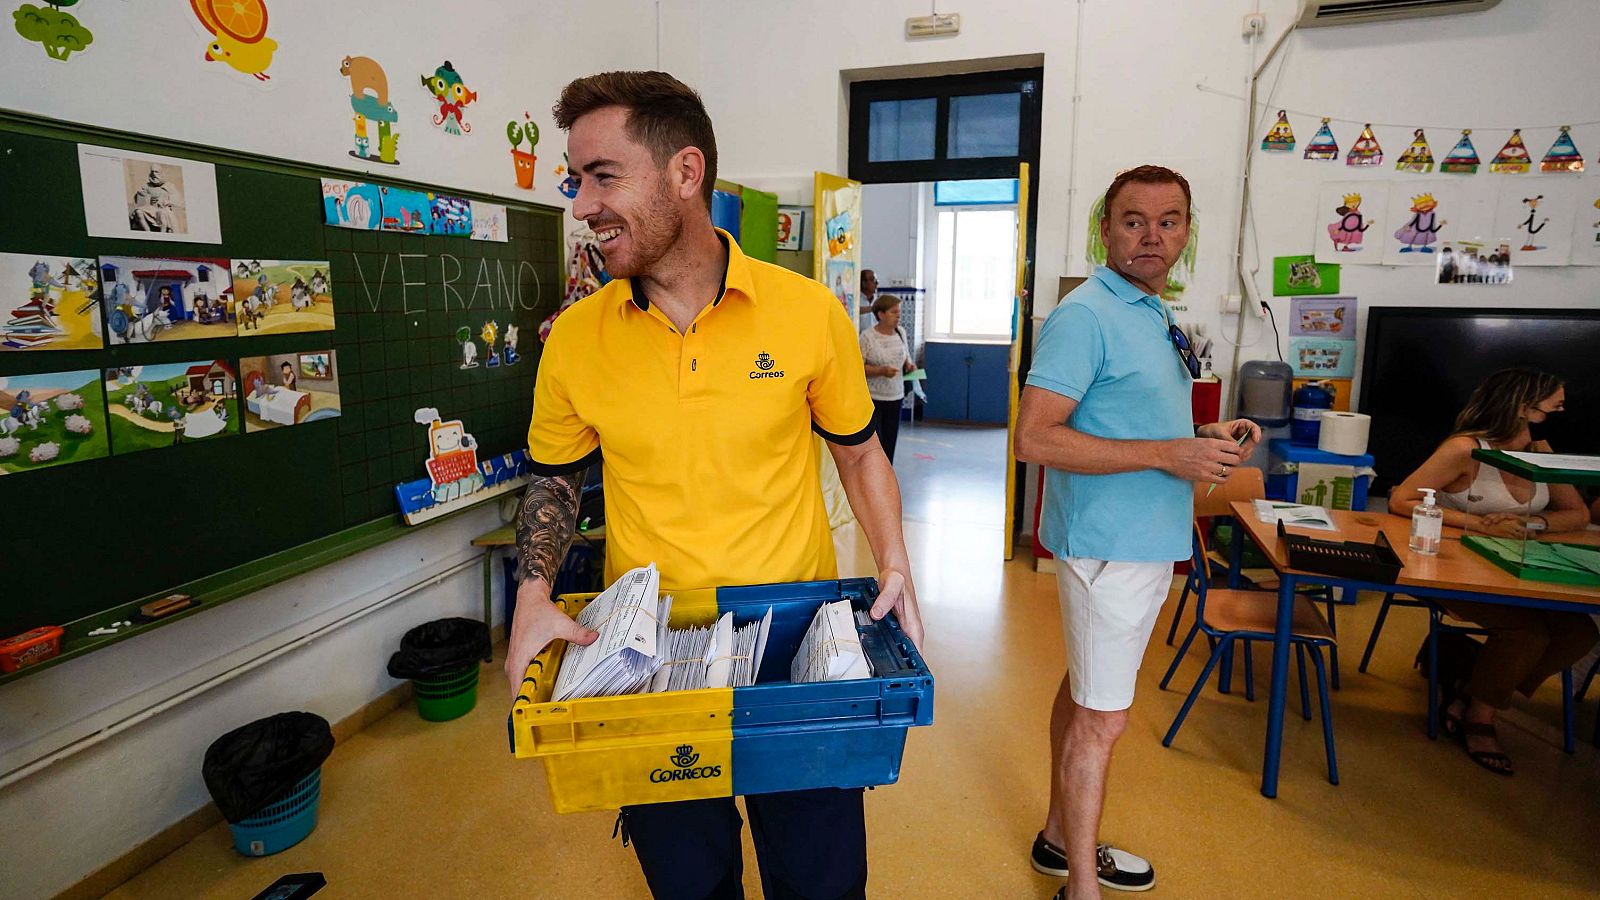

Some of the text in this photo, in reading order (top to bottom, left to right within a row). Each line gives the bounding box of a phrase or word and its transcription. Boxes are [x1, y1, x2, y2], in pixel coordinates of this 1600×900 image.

[352, 252, 541, 315] VERANO
[749, 370, 785, 379] Correos
[649, 765, 722, 784] CORREOS
